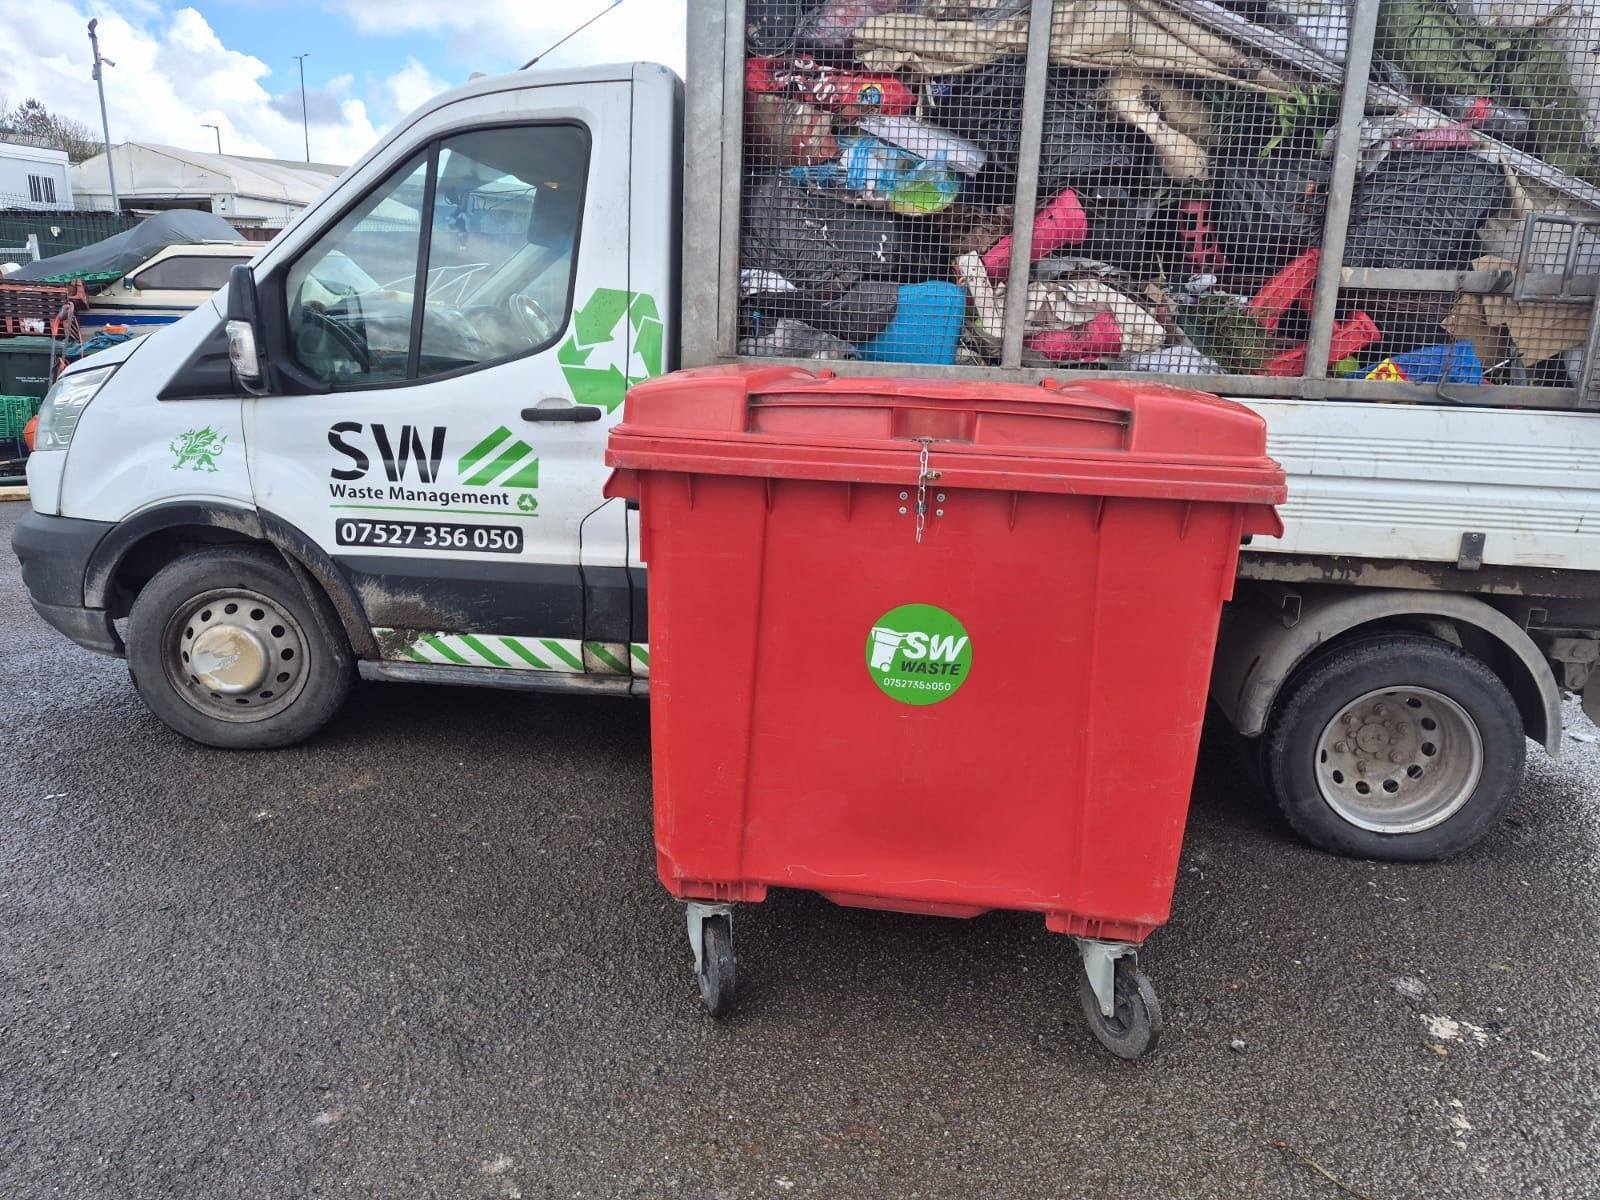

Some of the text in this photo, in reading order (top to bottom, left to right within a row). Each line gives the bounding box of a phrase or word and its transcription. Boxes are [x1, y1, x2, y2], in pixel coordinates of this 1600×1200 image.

[328, 421, 447, 484] SW
[329, 484, 509, 506] Waste Management
[341, 522, 518, 550] 07527 356 050
[902, 631, 969, 662] SW
[901, 660, 962, 676] WASTE
[883, 678, 952, 691] 07527356050
